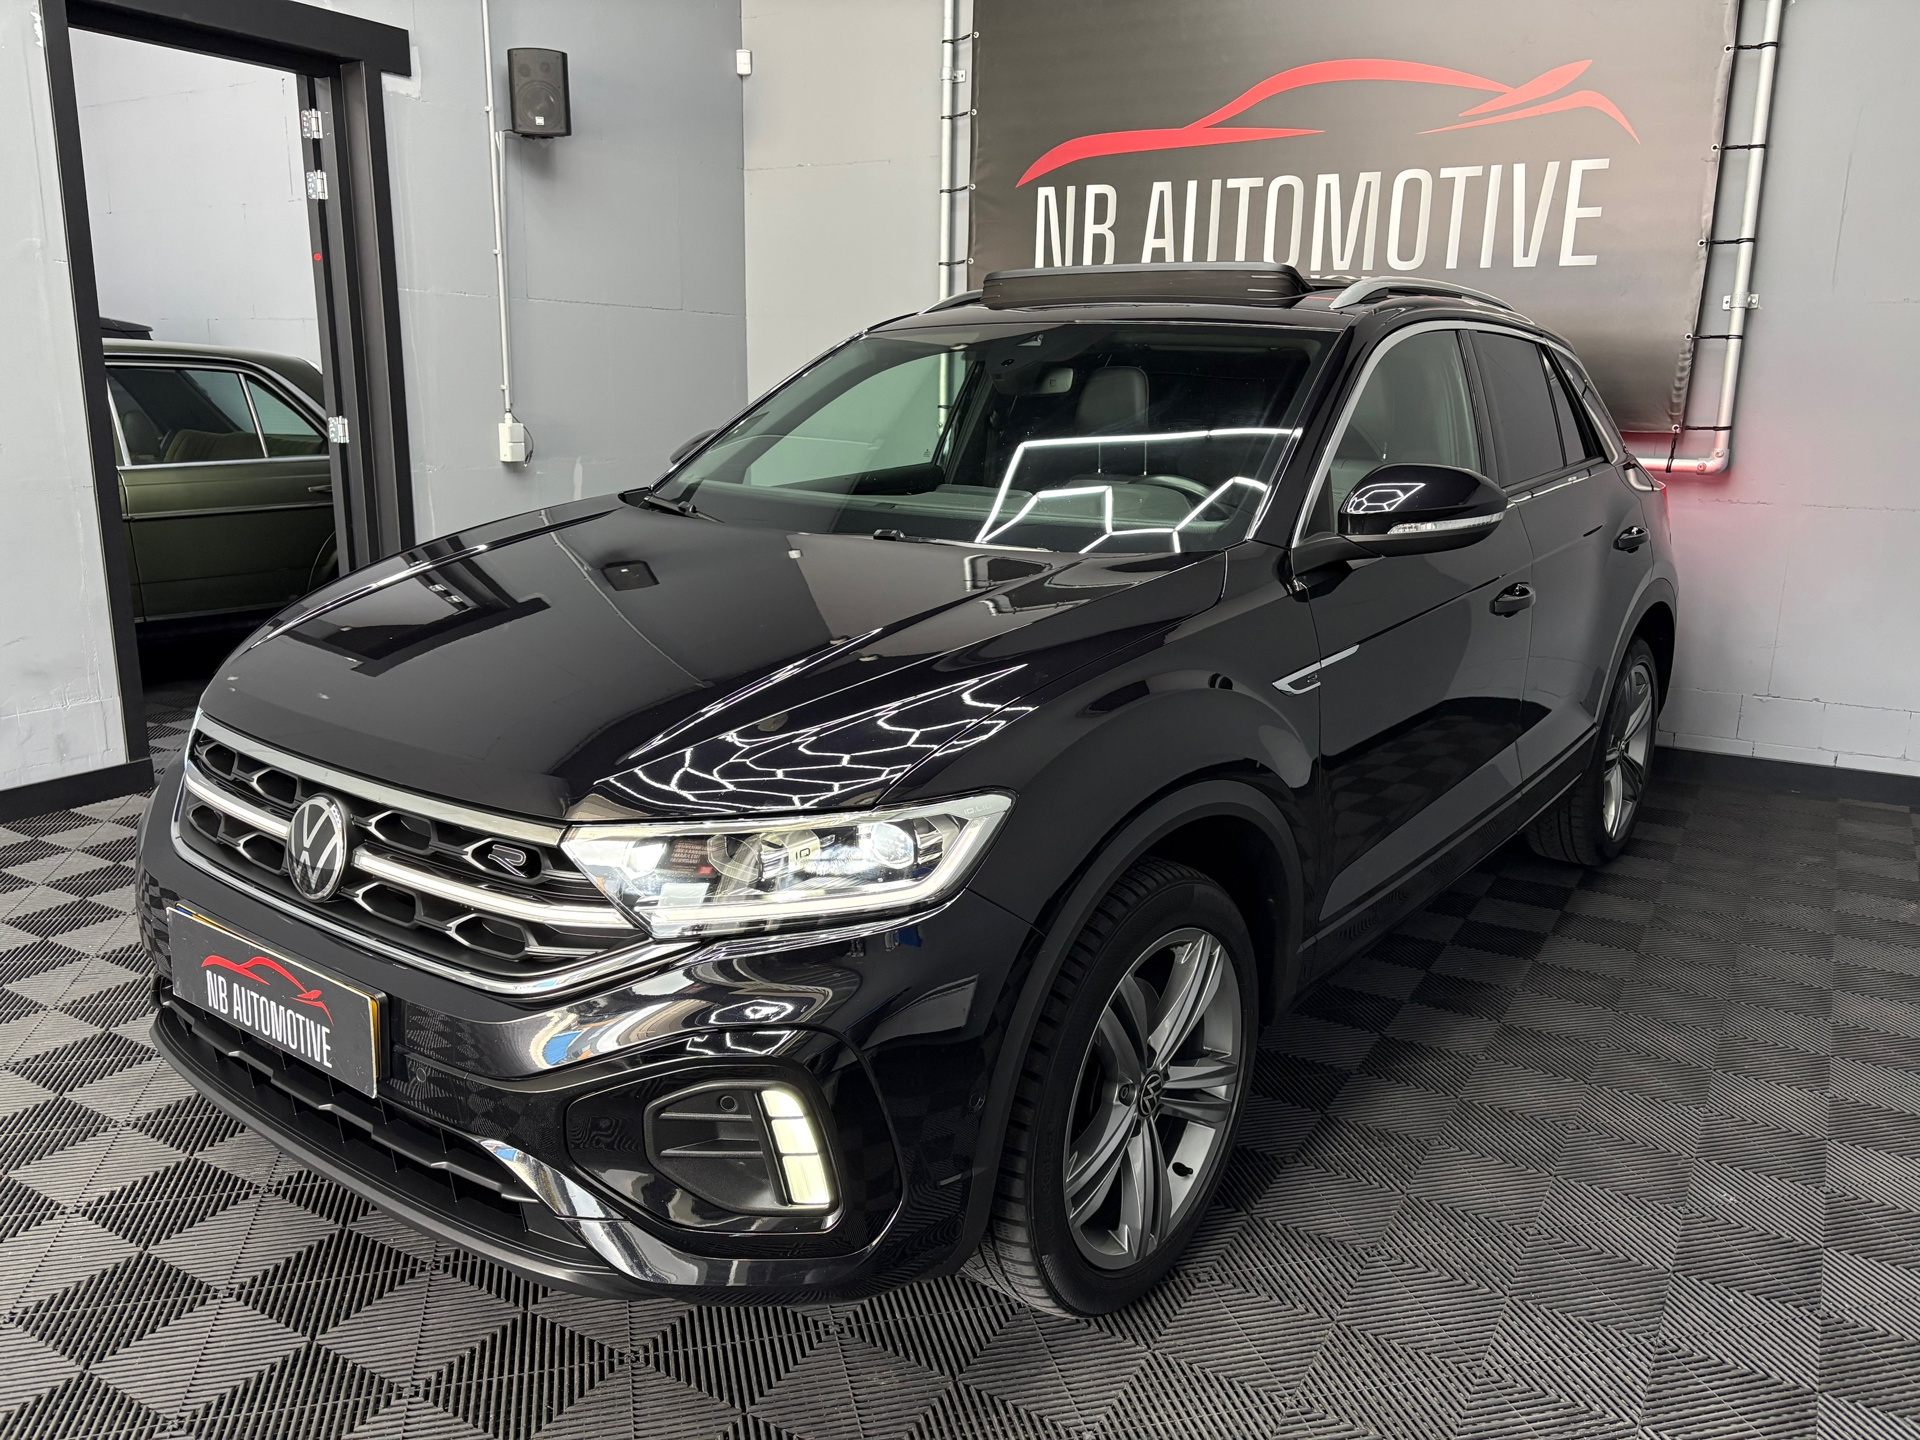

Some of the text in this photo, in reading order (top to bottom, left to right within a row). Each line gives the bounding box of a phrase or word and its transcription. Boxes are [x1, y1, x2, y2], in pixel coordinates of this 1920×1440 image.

[1141, 158, 1610, 271] AUTOMOTIVE
[205, 969, 333, 1069] NB AUTOMOTIVE
